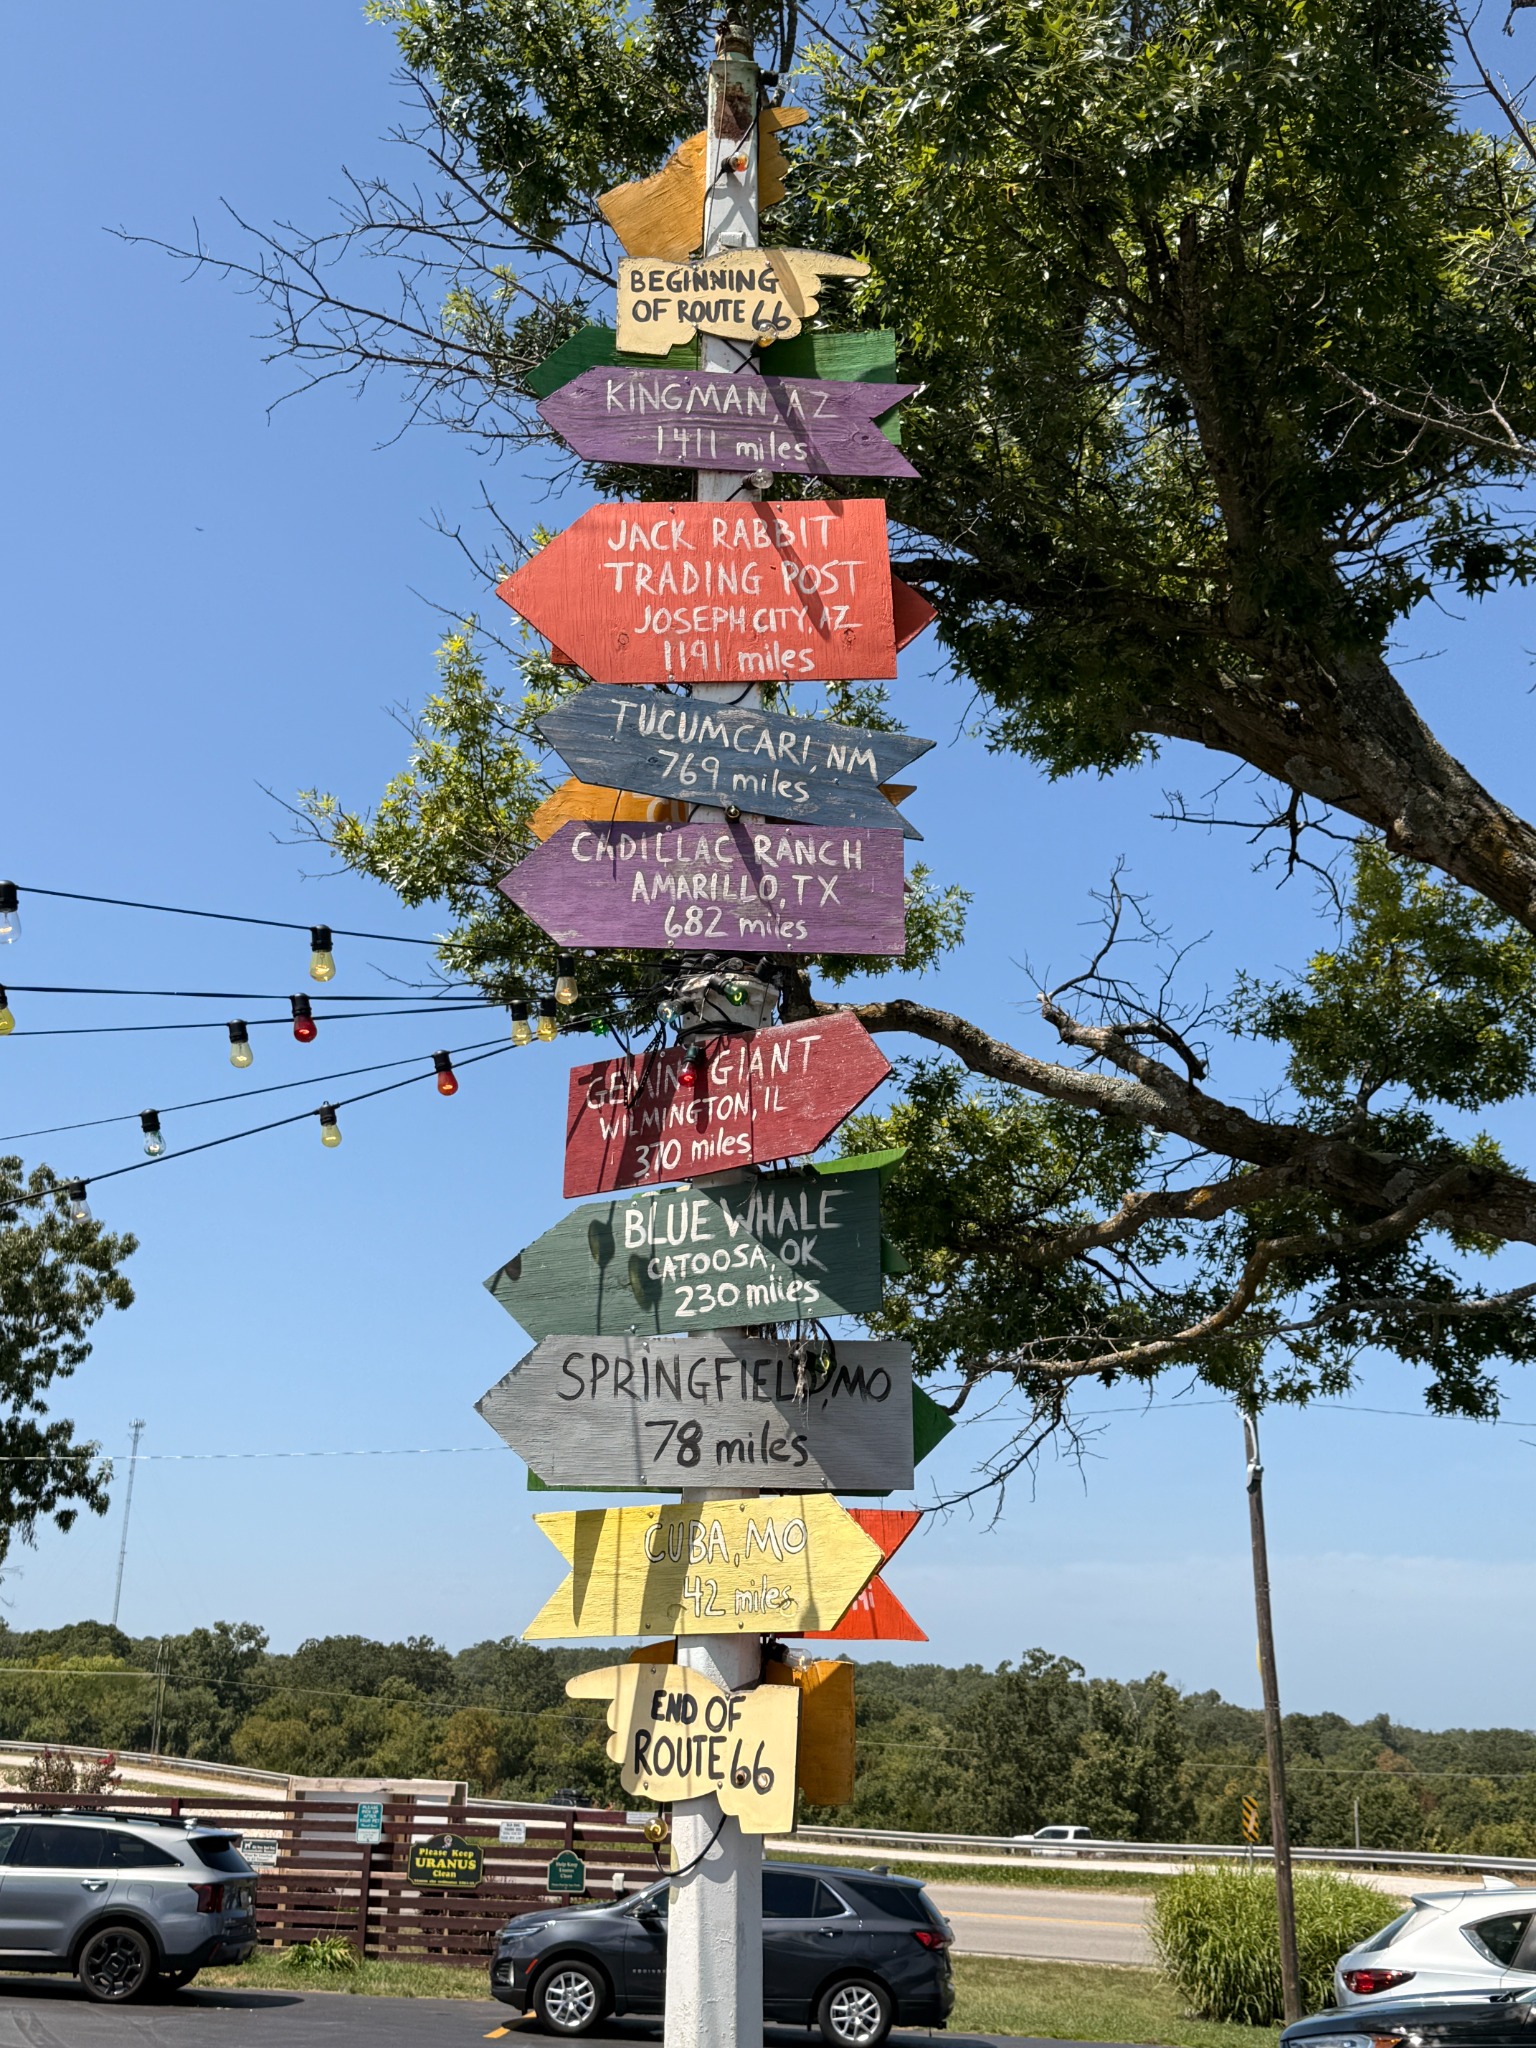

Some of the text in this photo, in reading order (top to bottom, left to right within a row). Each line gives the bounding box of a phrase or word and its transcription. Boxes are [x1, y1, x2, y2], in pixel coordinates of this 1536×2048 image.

[631, 267, 779, 294] BEGINNING
[632, 298, 792, 331] OF ROUTE 66
[606, 379, 839, 423] KINGMAN, AZ
[657, 425, 808, 462] 1411 miles
[608, 515, 844, 552] JACK RABBIT
[603, 560, 867, 597] TRADING POST
[634, 606, 746, 635] JOSEPH
[820, 606, 862, 630] AZ
[663, 639, 815, 673] 1191 miles
[657, 750, 810, 802] 769 miles
[826, 744, 880, 783] NM
[572, 831, 862, 870] CADILLAC RANCH
[792, 874, 841, 907] TX
[664, 906, 808, 940] 682 miles
[586, 1035, 822, 1110] GEMIN GIANT
[764, 1087, 789, 1112] IL
[634, 1128, 752, 1178] 370 miles
[624, 1189, 854, 1249] BLUE WHALE
[780, 1234, 829, 1272] OK
[675, 1274, 820, 1318] 230 miles
[644, 1419, 809, 1467] 78 miles
[683, 1575, 793, 1618] 42 miles
[651, 1690, 746, 1733] END OF
[634, 1728, 775, 1795] ROUTE 66
[415, 1857, 477, 1870] URANUS
[419, 1848, 474, 1859] Please Keep
[432, 1869, 457, 1878] Clean
